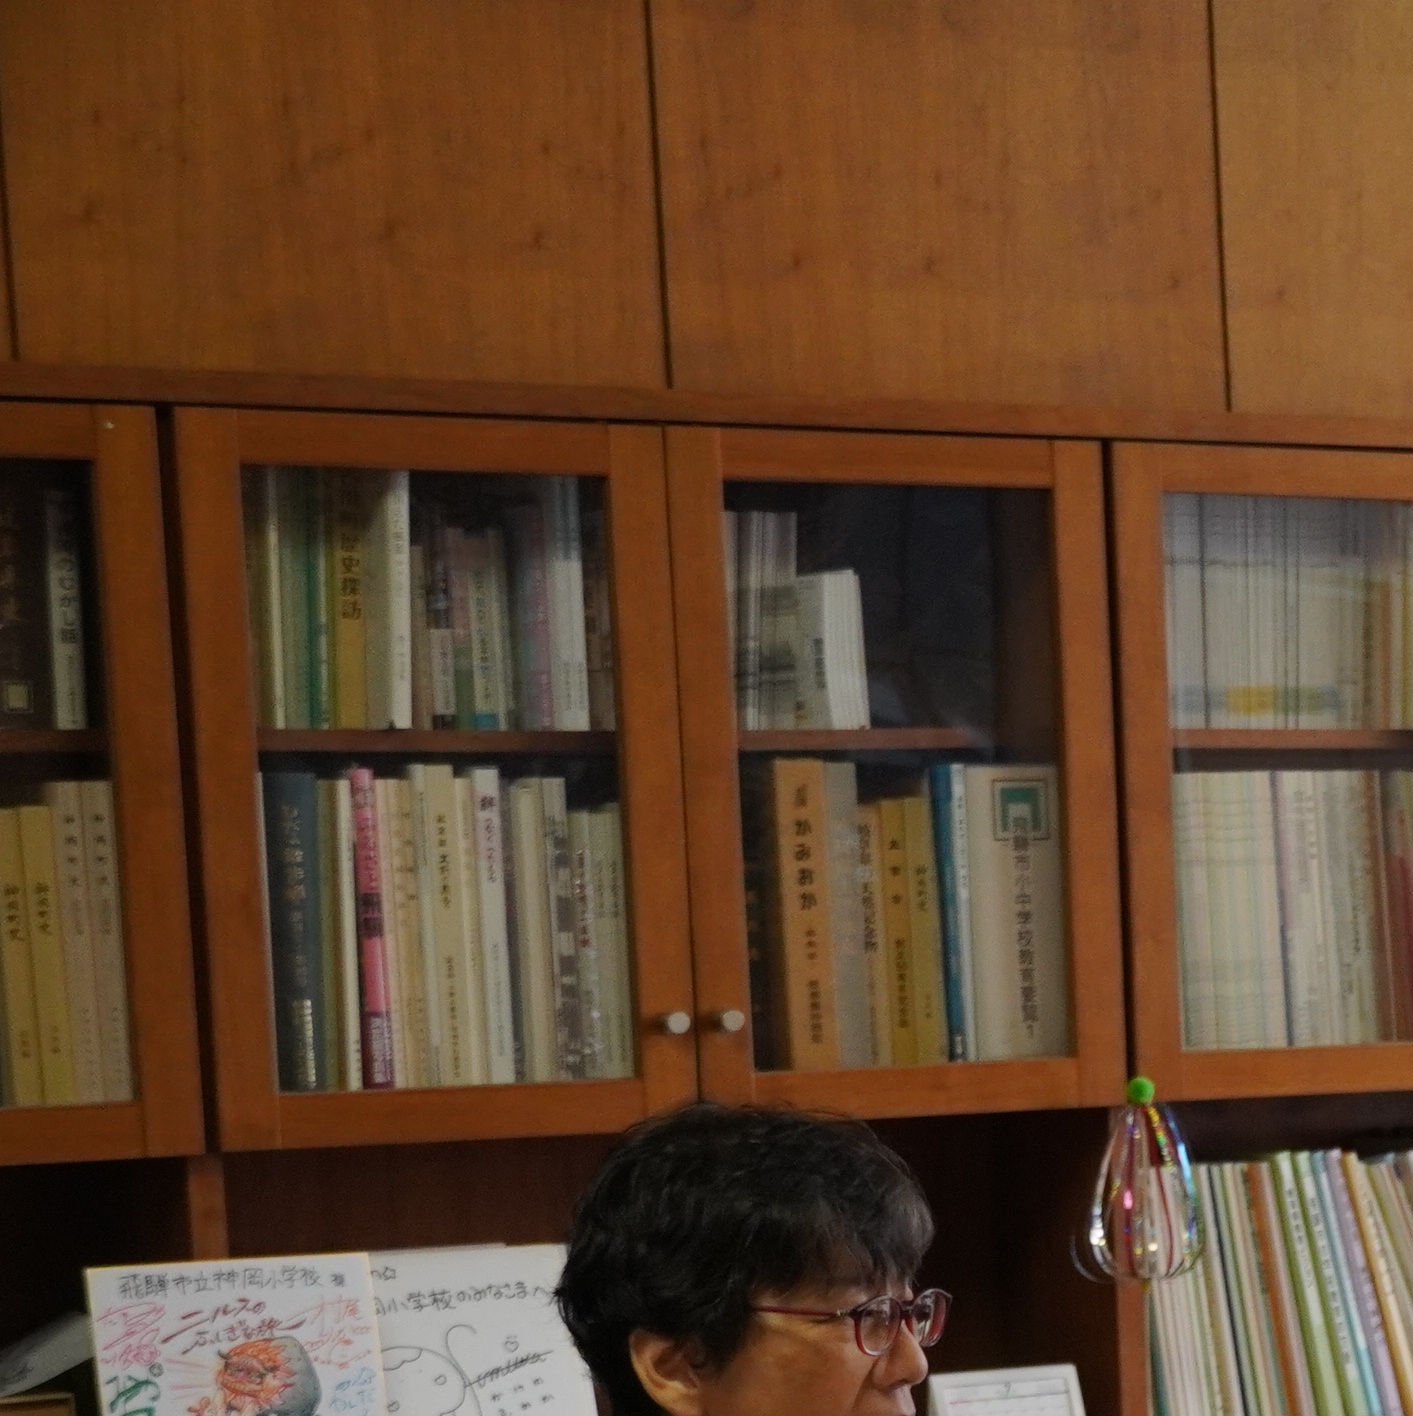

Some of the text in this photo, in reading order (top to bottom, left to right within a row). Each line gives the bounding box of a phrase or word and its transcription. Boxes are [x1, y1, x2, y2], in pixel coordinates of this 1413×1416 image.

[117, 1264, 324, 1299] 飛騨市立神岡小学校
